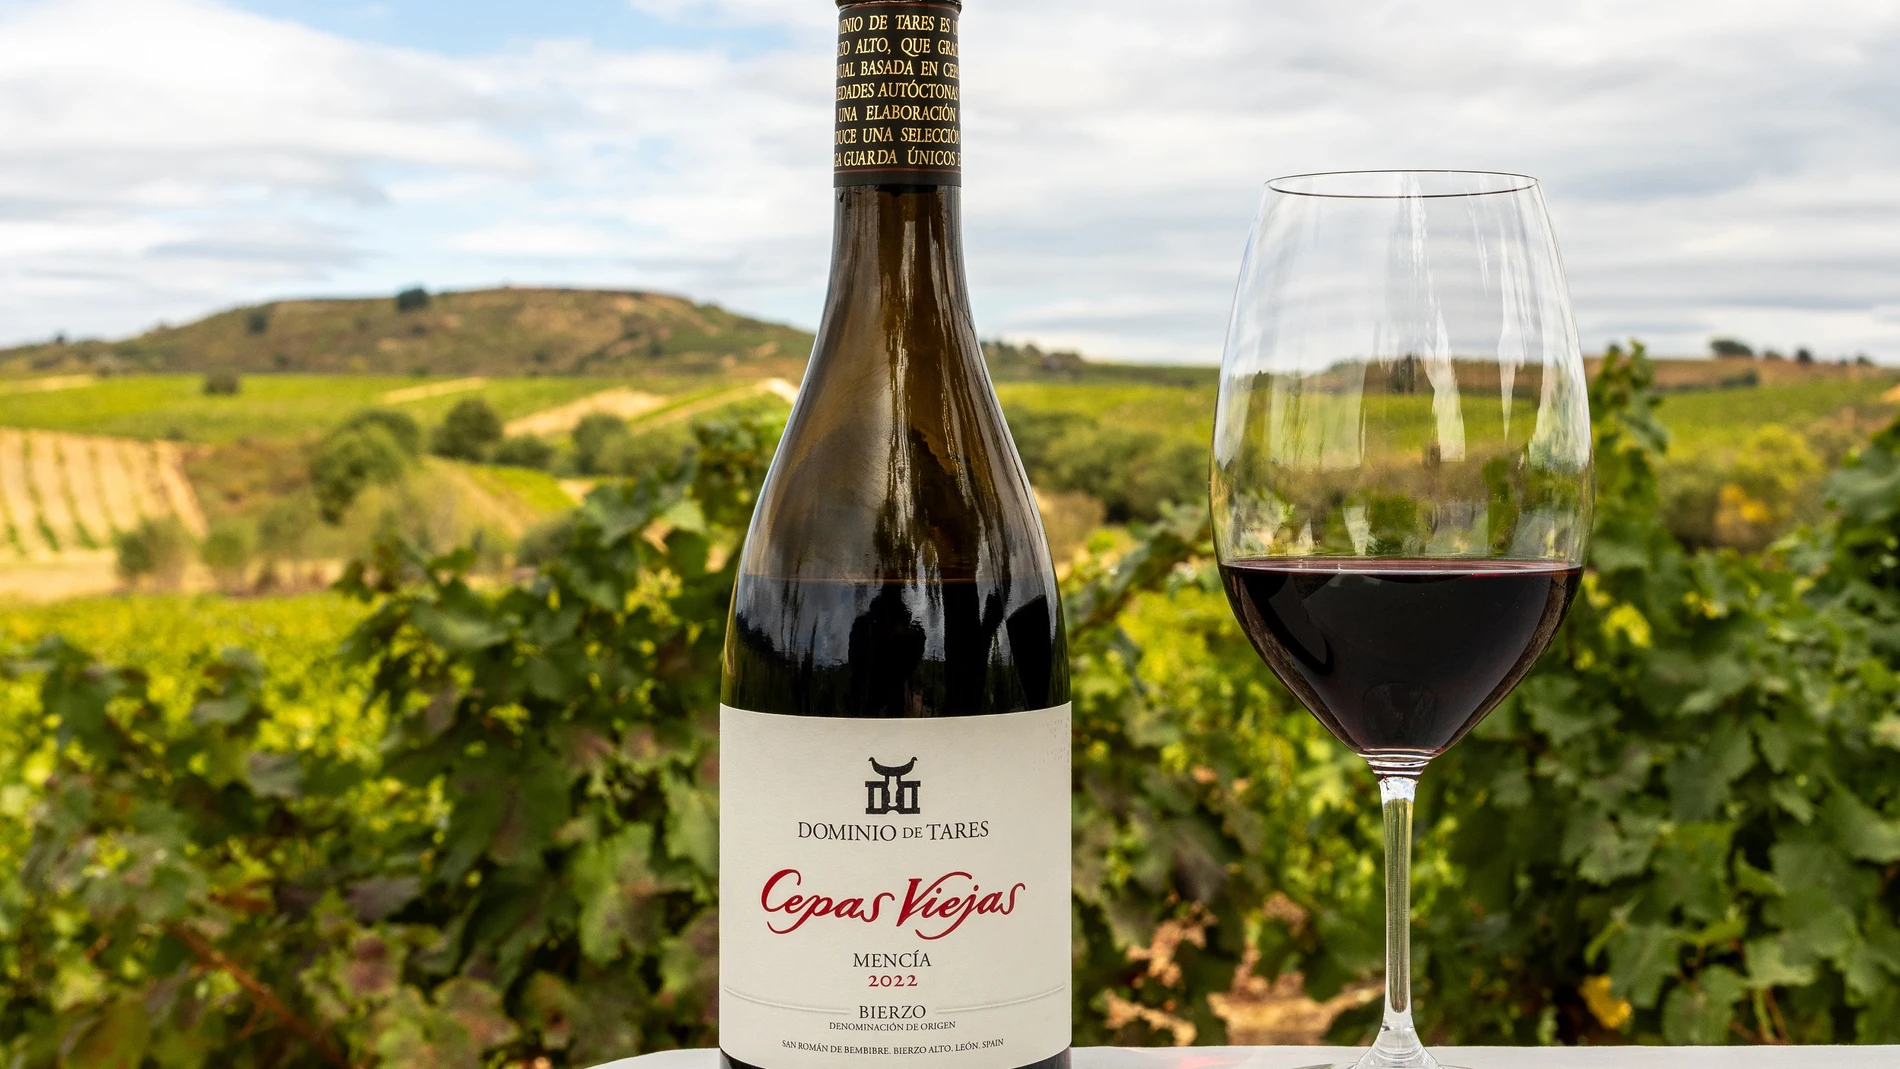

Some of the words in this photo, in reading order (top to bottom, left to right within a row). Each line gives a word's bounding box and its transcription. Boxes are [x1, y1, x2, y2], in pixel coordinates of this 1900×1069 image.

[868, 15, 888, 31] DE
[895, 14, 935, 31] TARES
[940, 16, 950, 33] ES
[855, 37, 892, 55] ALTO,
[901, 37, 931, 57] QUE
[860, 60, 914, 76] BASADA
[920, 61, 938, 76] EN
[877, 79, 959, 100] AUTÓCTONAS
[838, 105, 858, 123] UNA
[866, 103, 956, 122] ELABORACIÓN
[862, 127, 893, 143] UNA
[900, 126, 960, 144] SELECCIÓN
[844, 149, 898, 167] GUARDA
[907, 146, 956, 166] ÚNICOS
[798, 821, 897, 841] DOMINIO
[902, 826, 923, 839] DE
[926, 820, 989, 841] TARES
[760, 868, 895, 934] Cepas
[896, 871, 1026, 940] Viejas
[853, 949, 932, 968] MENCÍA
[868, 974, 918, 987] 2022
[859, 1004, 926, 1019] BIERZO
[829, 1021, 904, 1032] DENOMINACIÓN
[906, 1023, 919, 1031] DE
[920, 1021, 956, 1031] ORIGEN
[782, 1039, 796, 1049] SAN
[798, 1041, 828, 1052] ROMÁN
[830, 1045, 843, 1053] DE
[893, 1046, 927, 1055] BIERZO
[982, 1038, 1004, 1049] SPAIN
